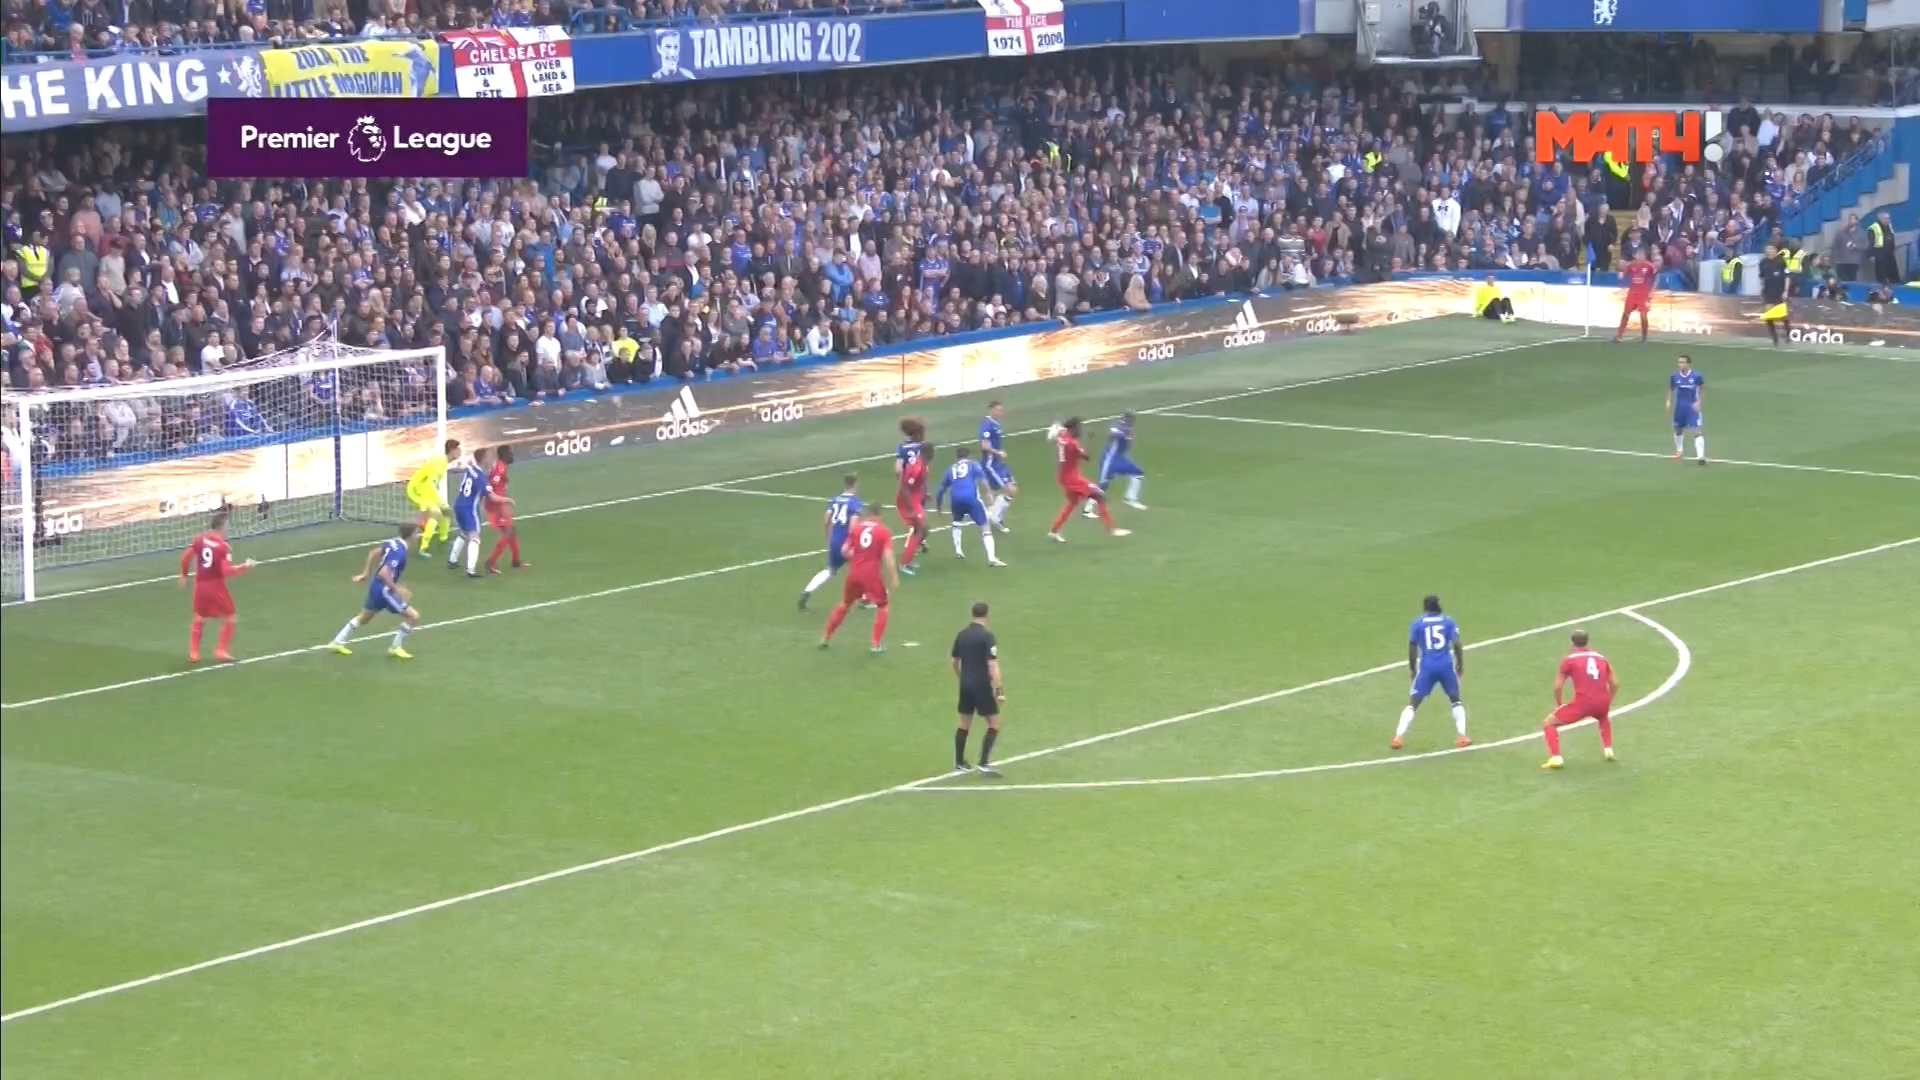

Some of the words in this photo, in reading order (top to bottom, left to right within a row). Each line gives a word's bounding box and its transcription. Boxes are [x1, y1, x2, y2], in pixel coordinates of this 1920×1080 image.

[689, 21, 812, 69] TAMBLING
[817, 21, 861, 62] 202
[992, 35, 1022, 50] 1971
[334, 46, 370, 64] THE
[469, 45, 536, 64] CHELSEA
[539, 43, 557, 57] FC
[473, 65, 495, 76] JON
[534, 59, 562, 71] OVER
[532, 71, 558, 83] LAND
[1, 69, 70, 118] HE
[84, 59, 209, 110] KING
[655, 416, 710, 441] adidas
[951, 462, 969, 480] 19
[860, 527, 873, 549] 6
[202, 547, 214, 569] 9
[1424, 624, 1446, 650] 15
[1586, 657, 1600, 680] 4
